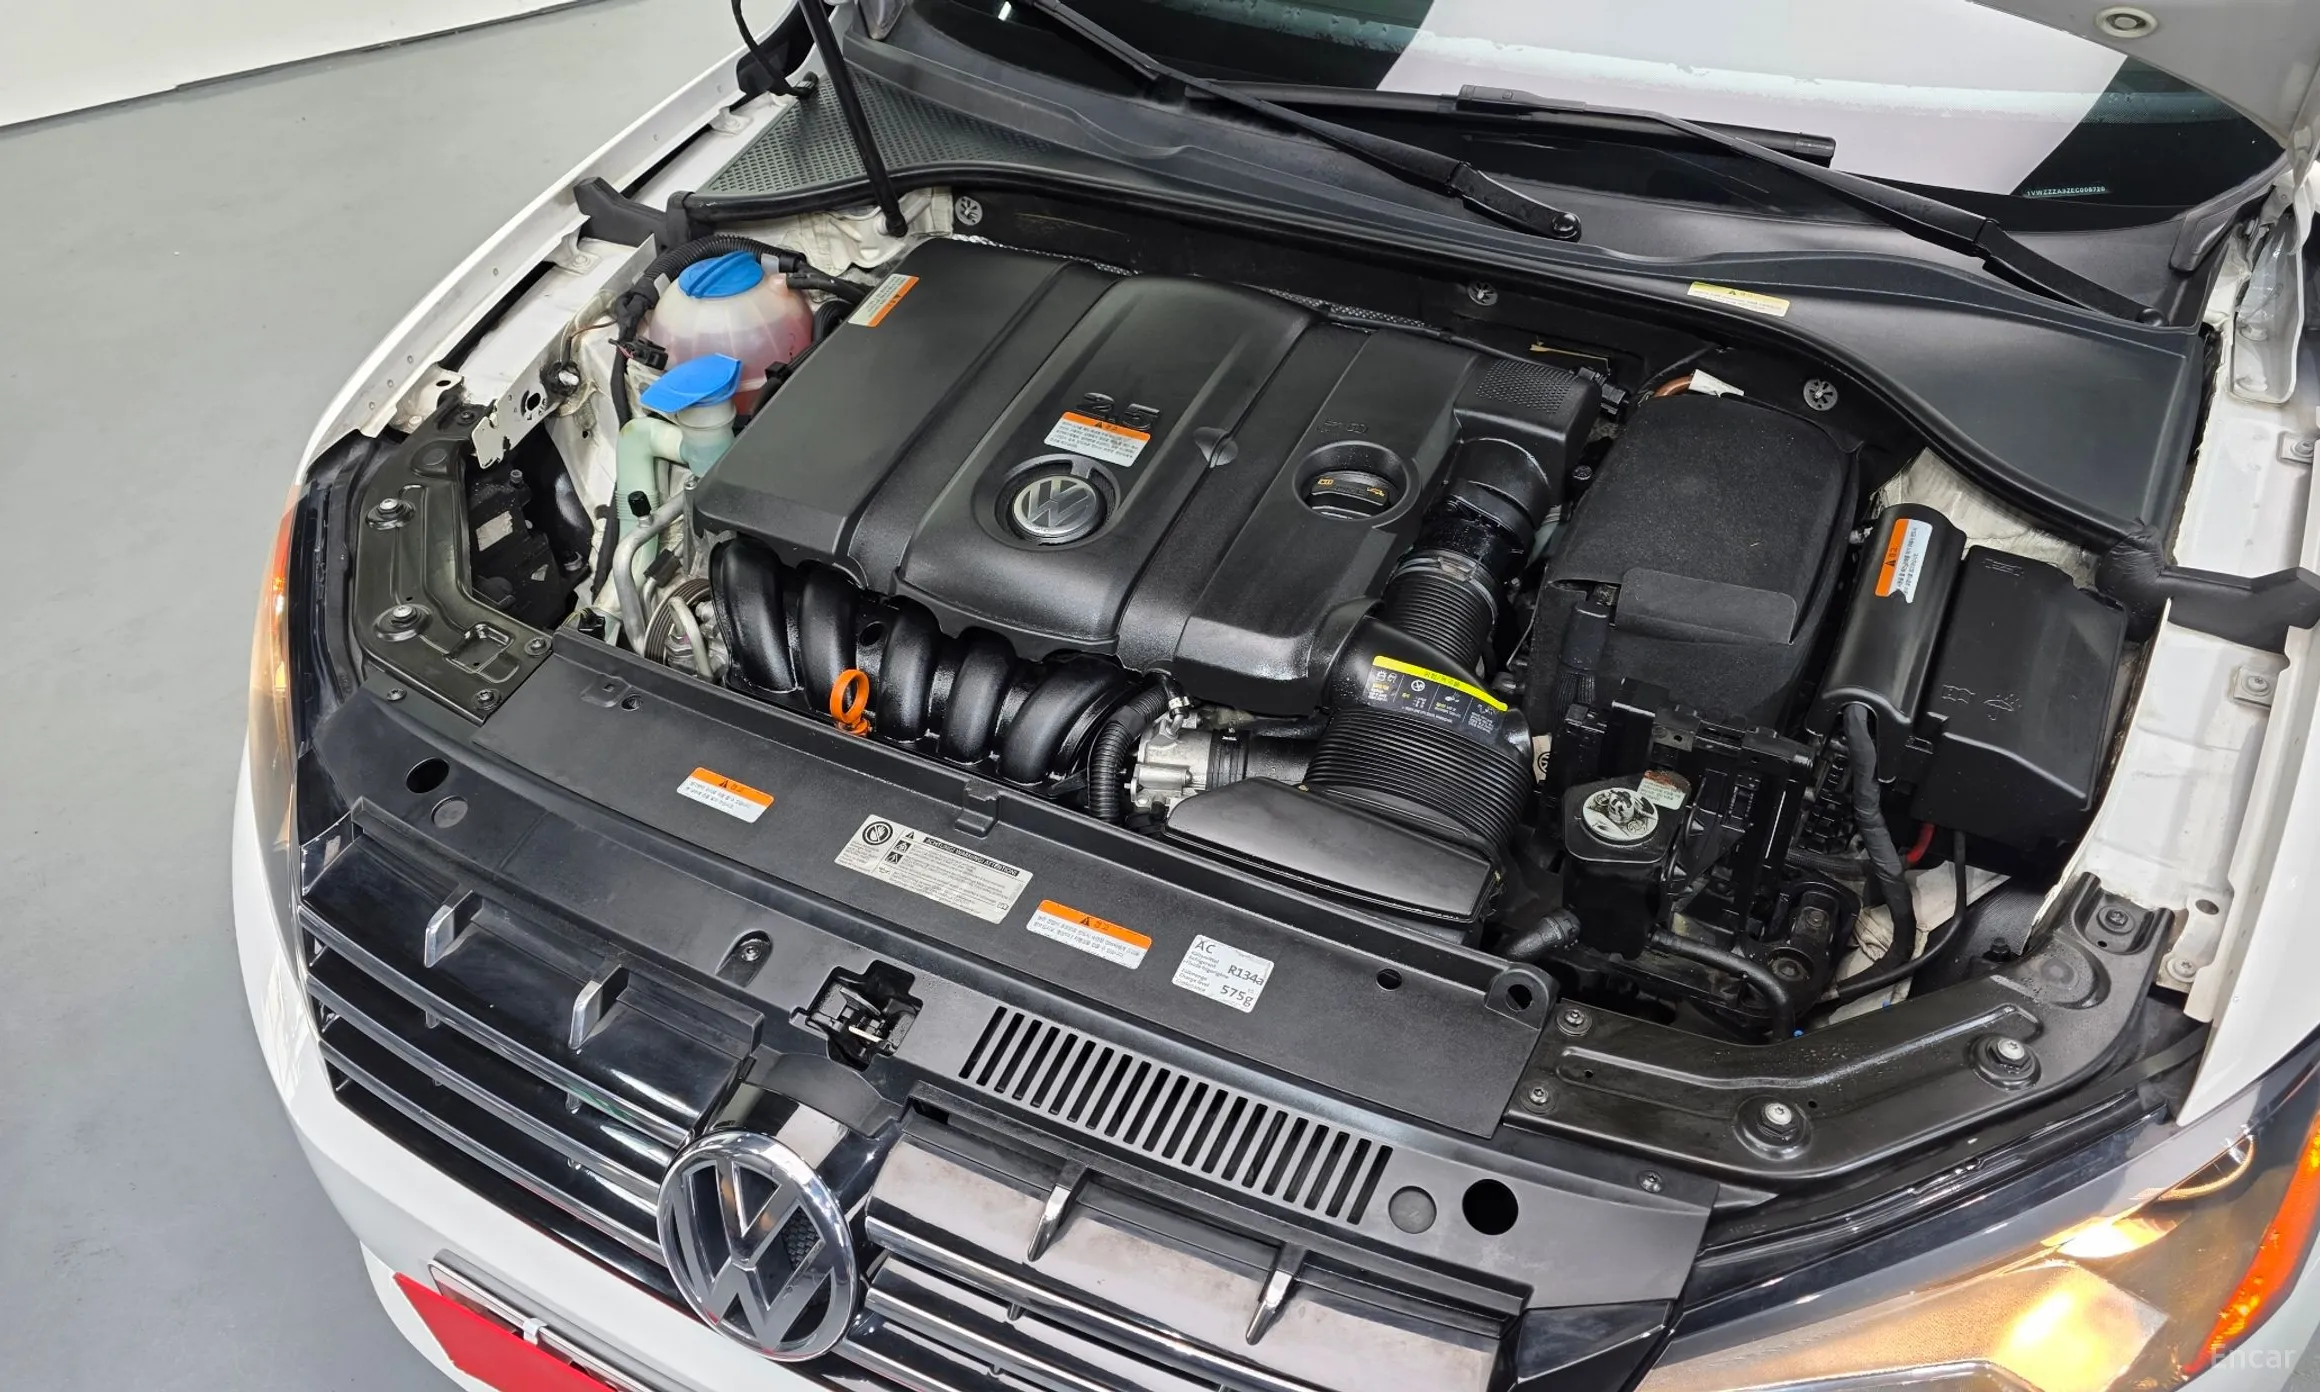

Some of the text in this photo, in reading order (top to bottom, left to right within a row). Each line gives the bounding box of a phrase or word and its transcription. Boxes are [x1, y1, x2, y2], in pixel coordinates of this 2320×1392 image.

[1195, 940, 1216, 954] AC
[1227, 964, 1265, 986] R134a
[1220, 984, 1254, 1008] 575g
[656, 1131, 858, 1363] VW
